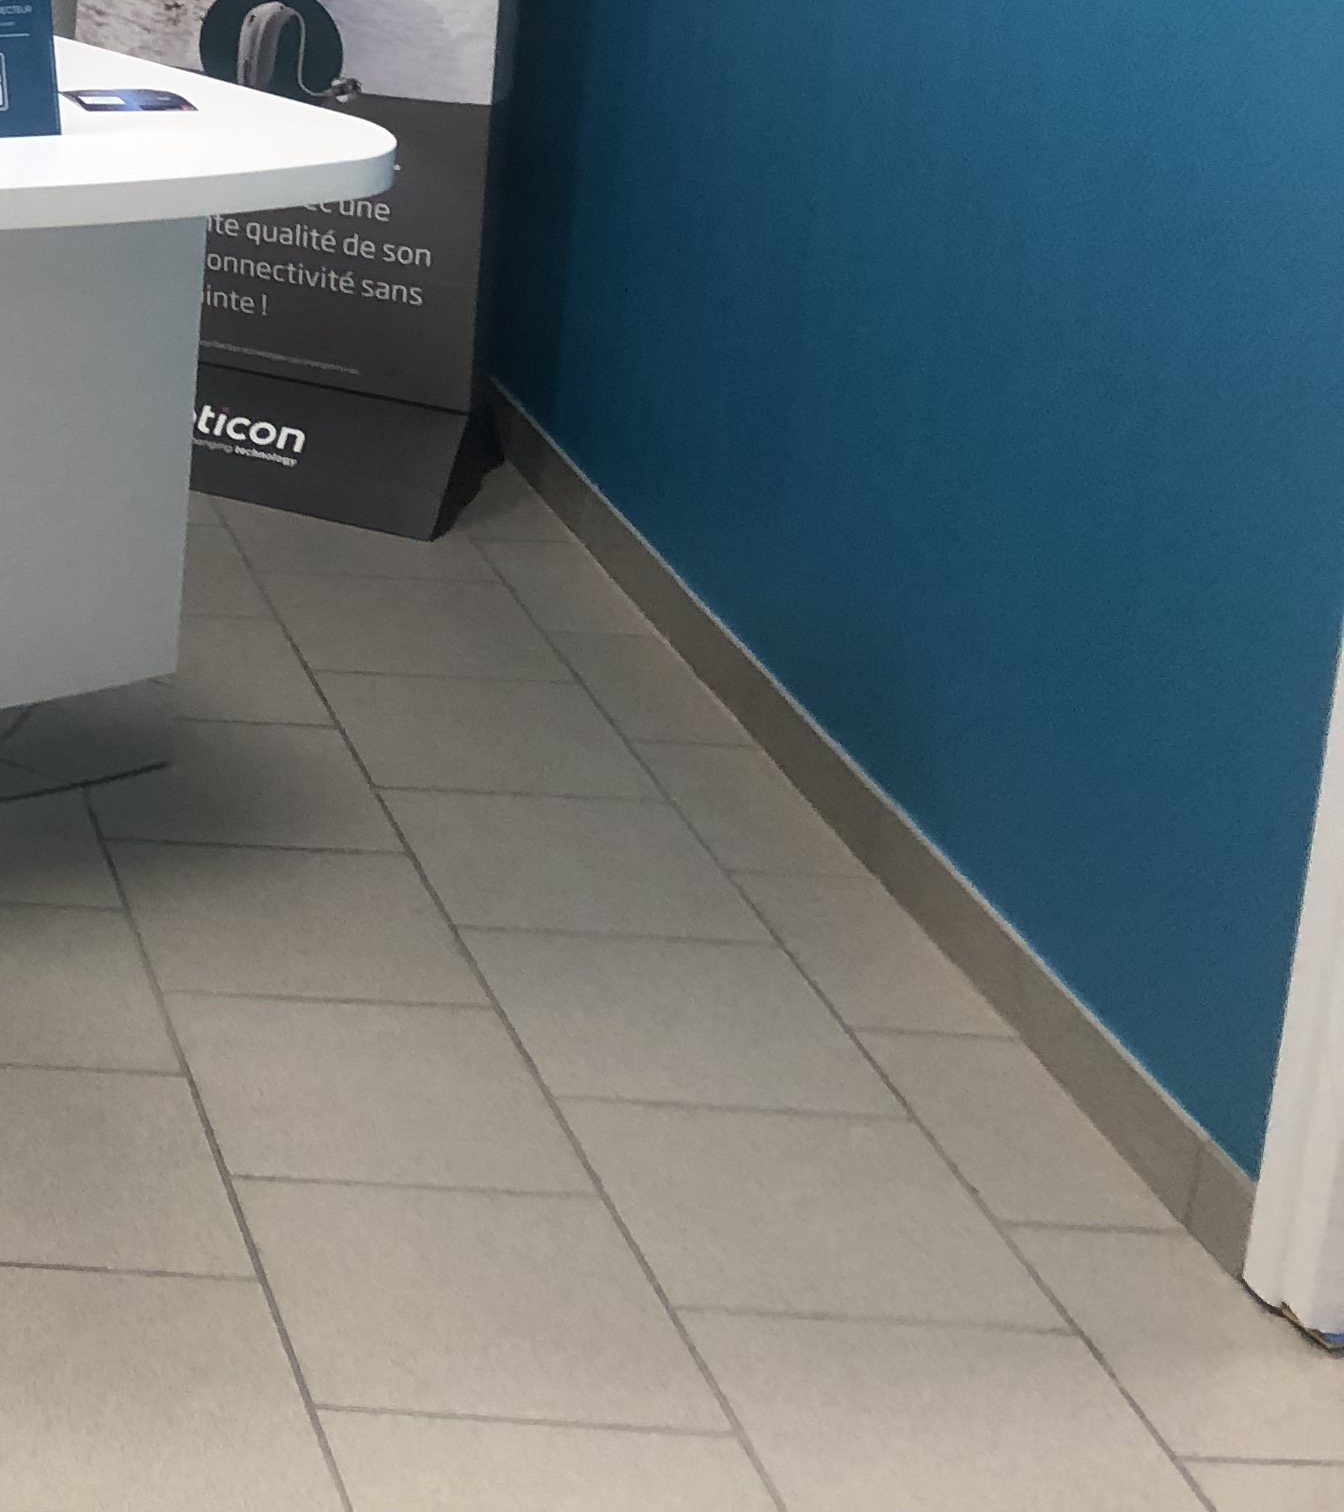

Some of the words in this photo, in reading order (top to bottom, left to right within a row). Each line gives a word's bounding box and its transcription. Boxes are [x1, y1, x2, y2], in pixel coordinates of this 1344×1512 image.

[339, 199, 391, 222] une
[245, 222, 336, 254] qualité
[342, 233, 377, 259] de
[382, 243, 432, 268] son
[360, 279, 424, 307] sans
[192, 404, 306, 454] ticon
